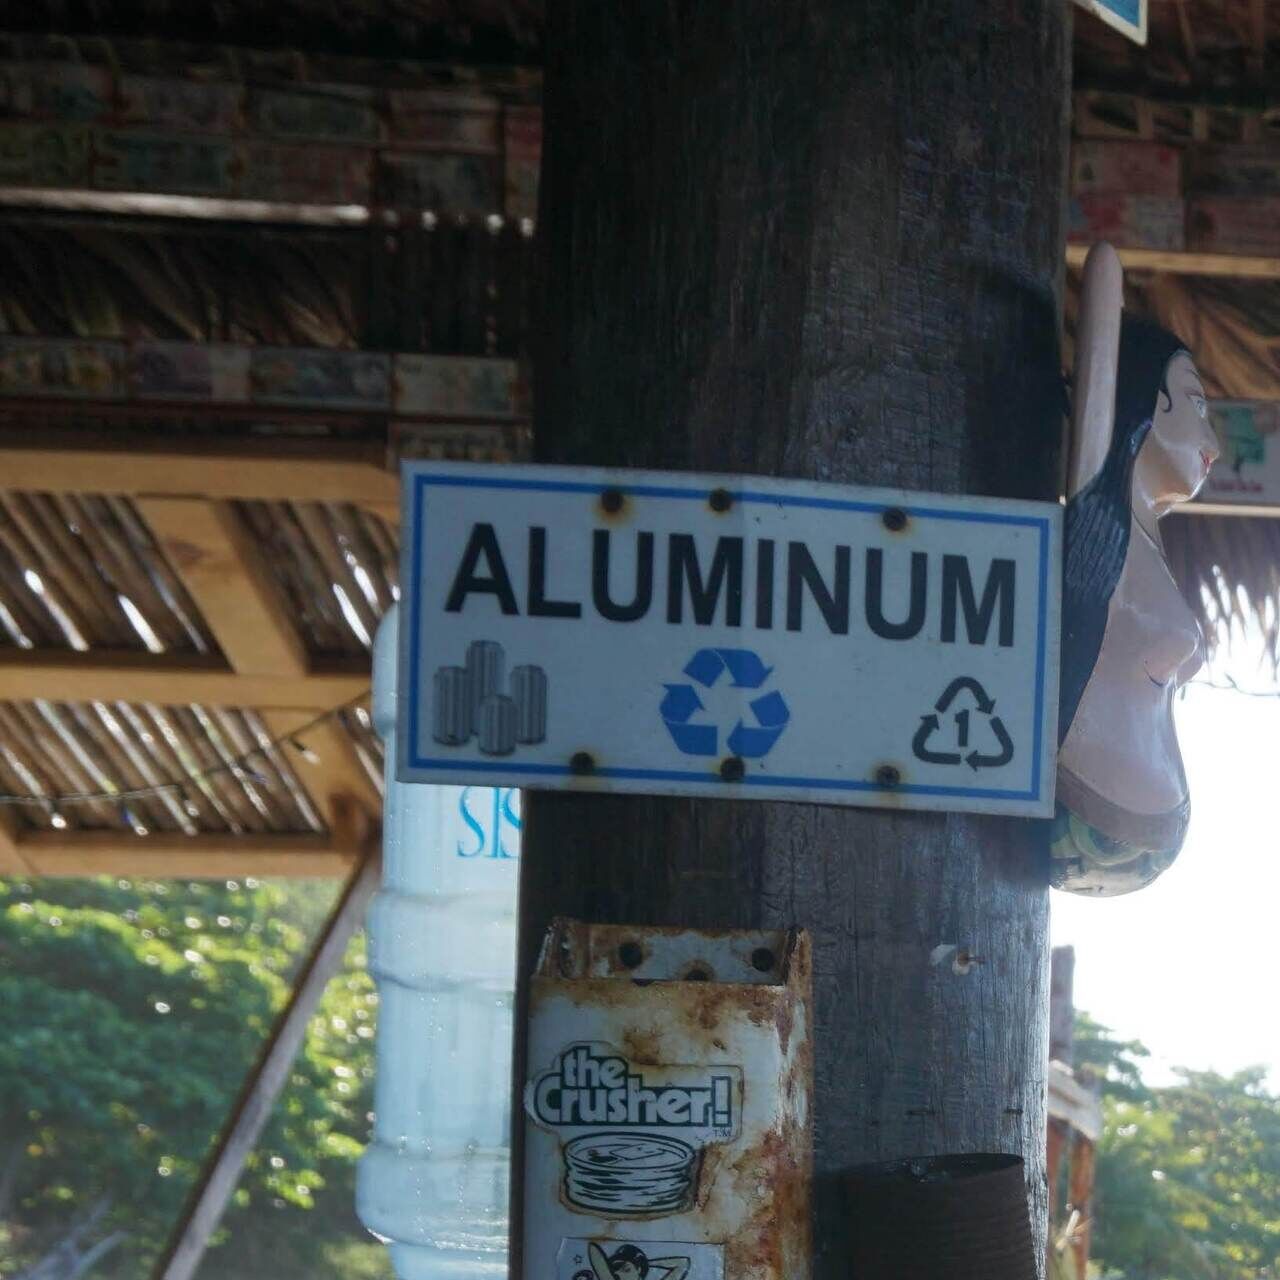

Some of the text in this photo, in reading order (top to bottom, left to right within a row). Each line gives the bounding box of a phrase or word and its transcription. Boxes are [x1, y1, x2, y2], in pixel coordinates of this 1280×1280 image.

[445, 522, 1017, 648] ALUMINUM
[954, 709, 970, 747] 1
[560, 1047, 629, 1089] the
[534, 1073, 732, 1127] Crusher!
